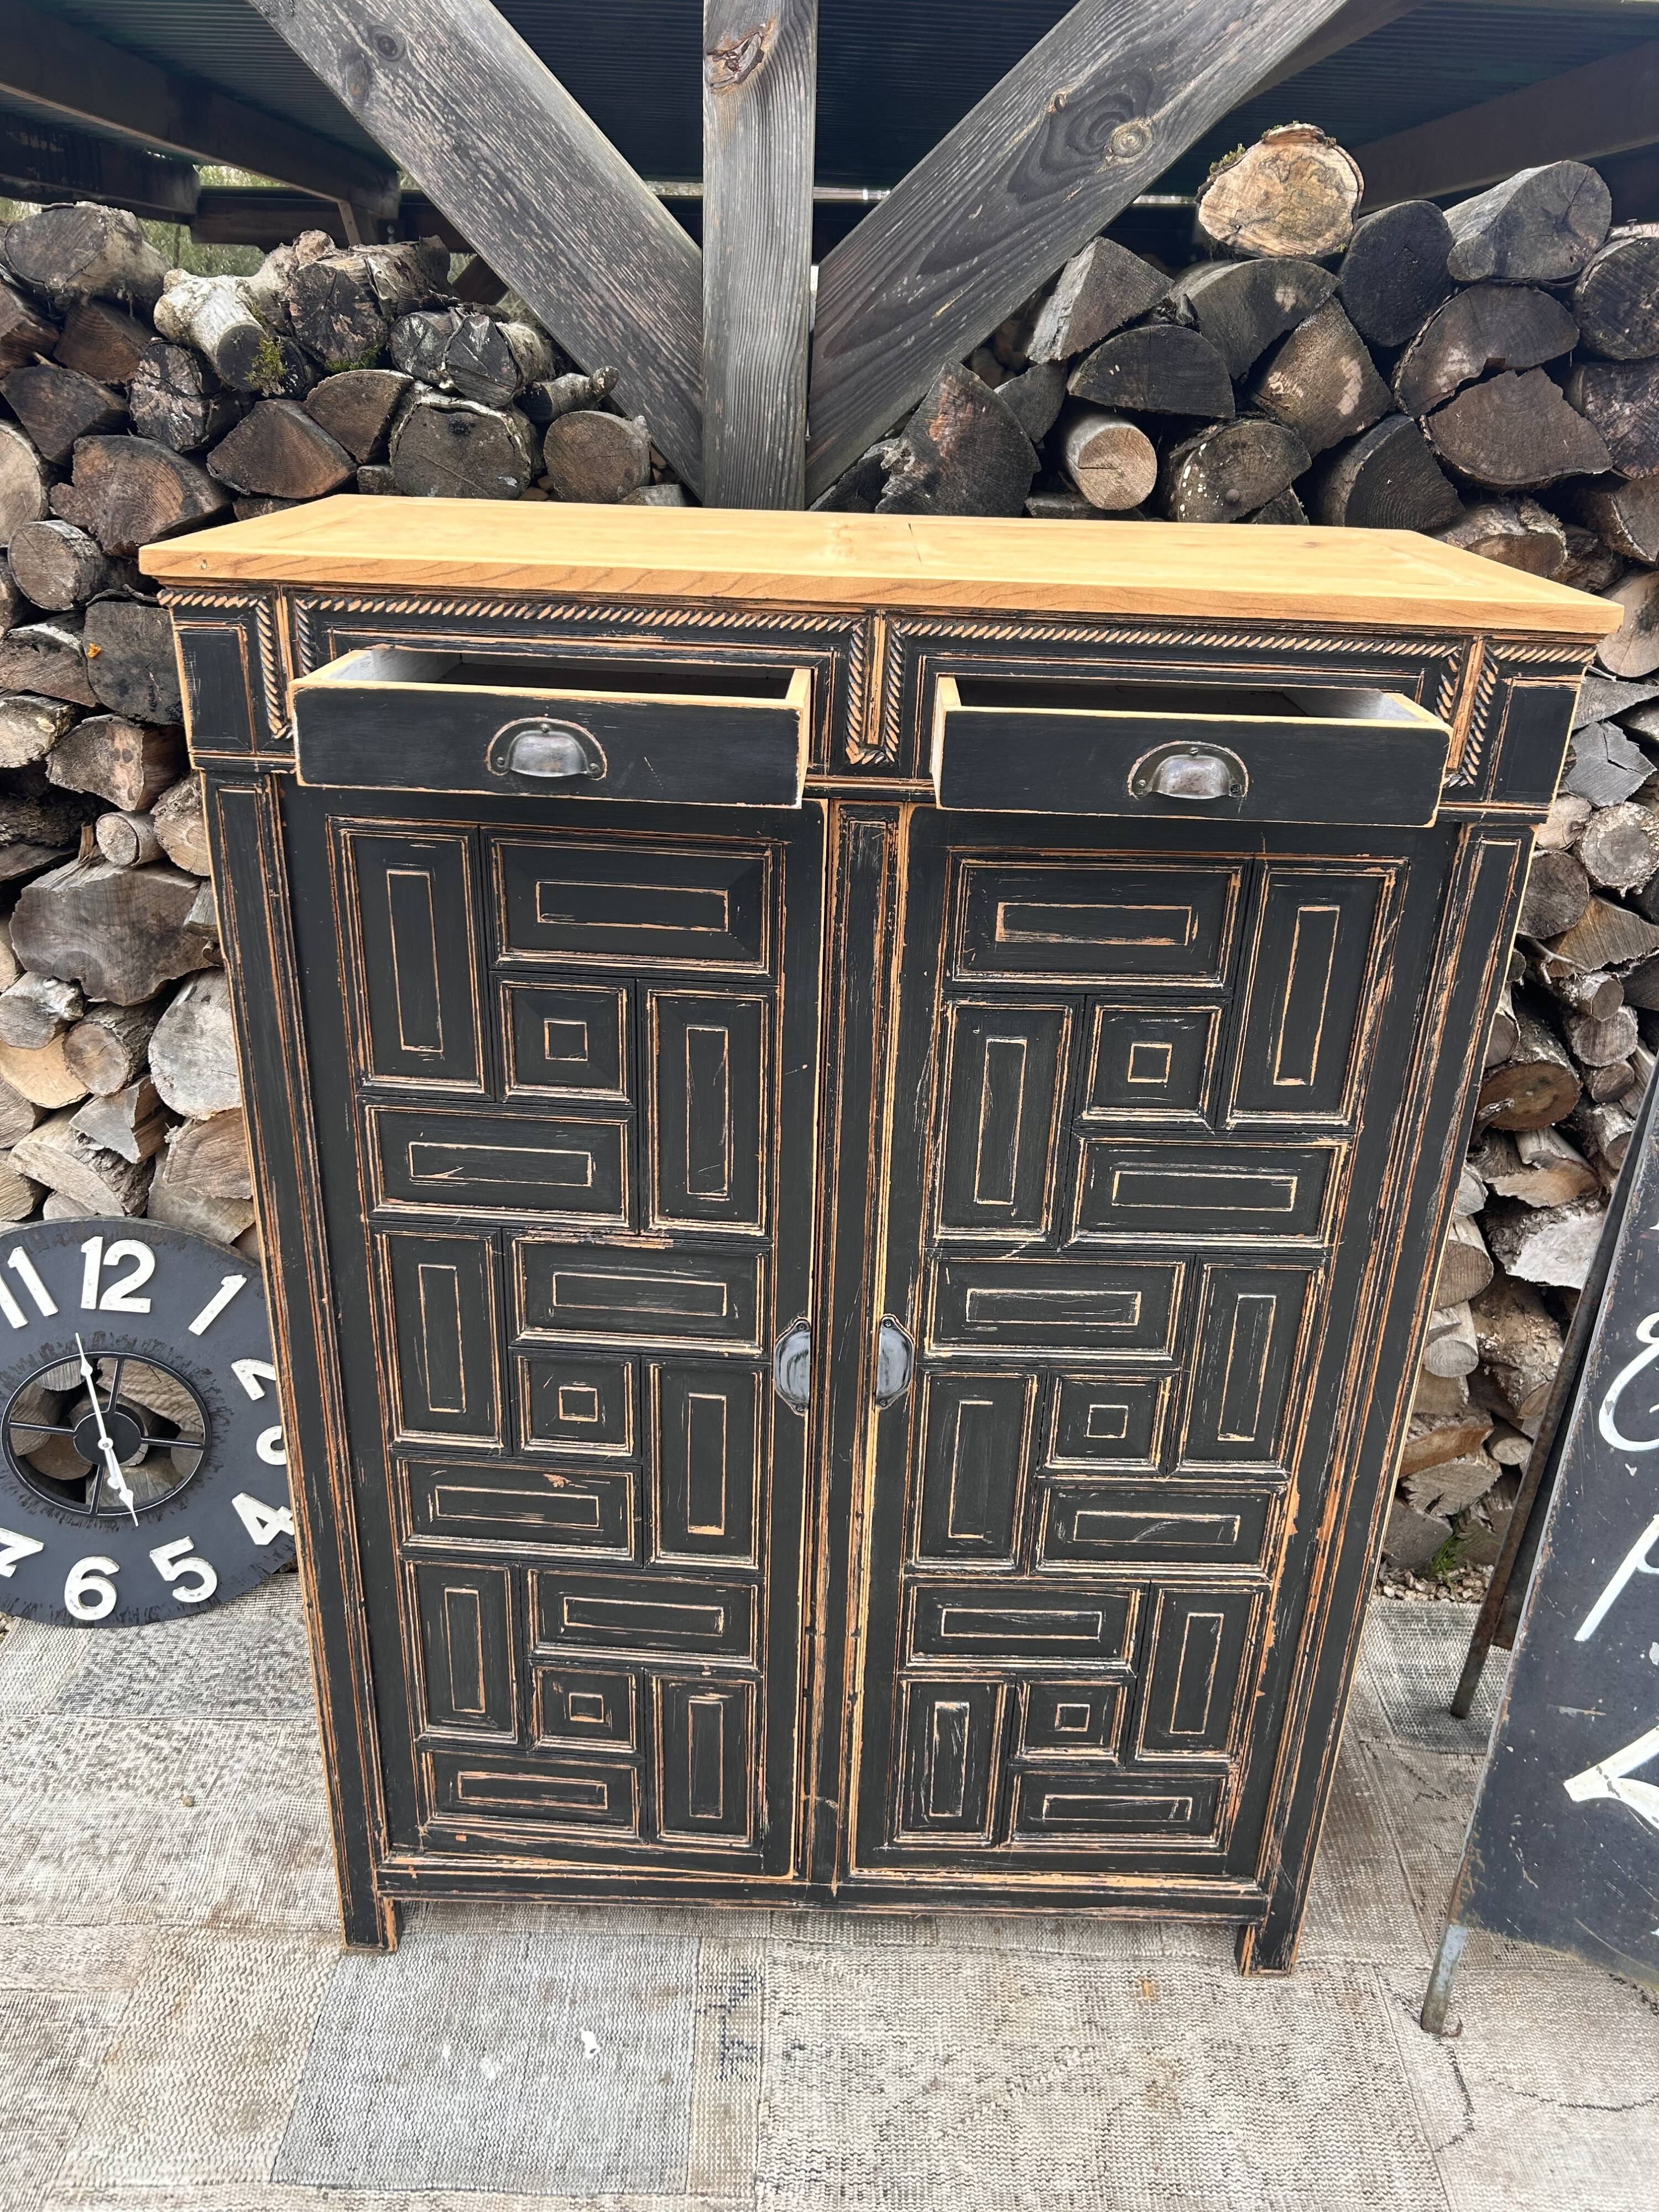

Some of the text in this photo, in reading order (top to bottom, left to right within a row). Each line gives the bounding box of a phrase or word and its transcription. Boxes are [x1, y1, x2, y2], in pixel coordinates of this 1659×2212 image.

[80, 1236, 156, 1313] 12
[188, 1274, 247, 1335] 1
[231, 1492, 296, 1546] 4
[64, 1556, 120, 1621] 6
[149, 1536, 217, 1603] 5
